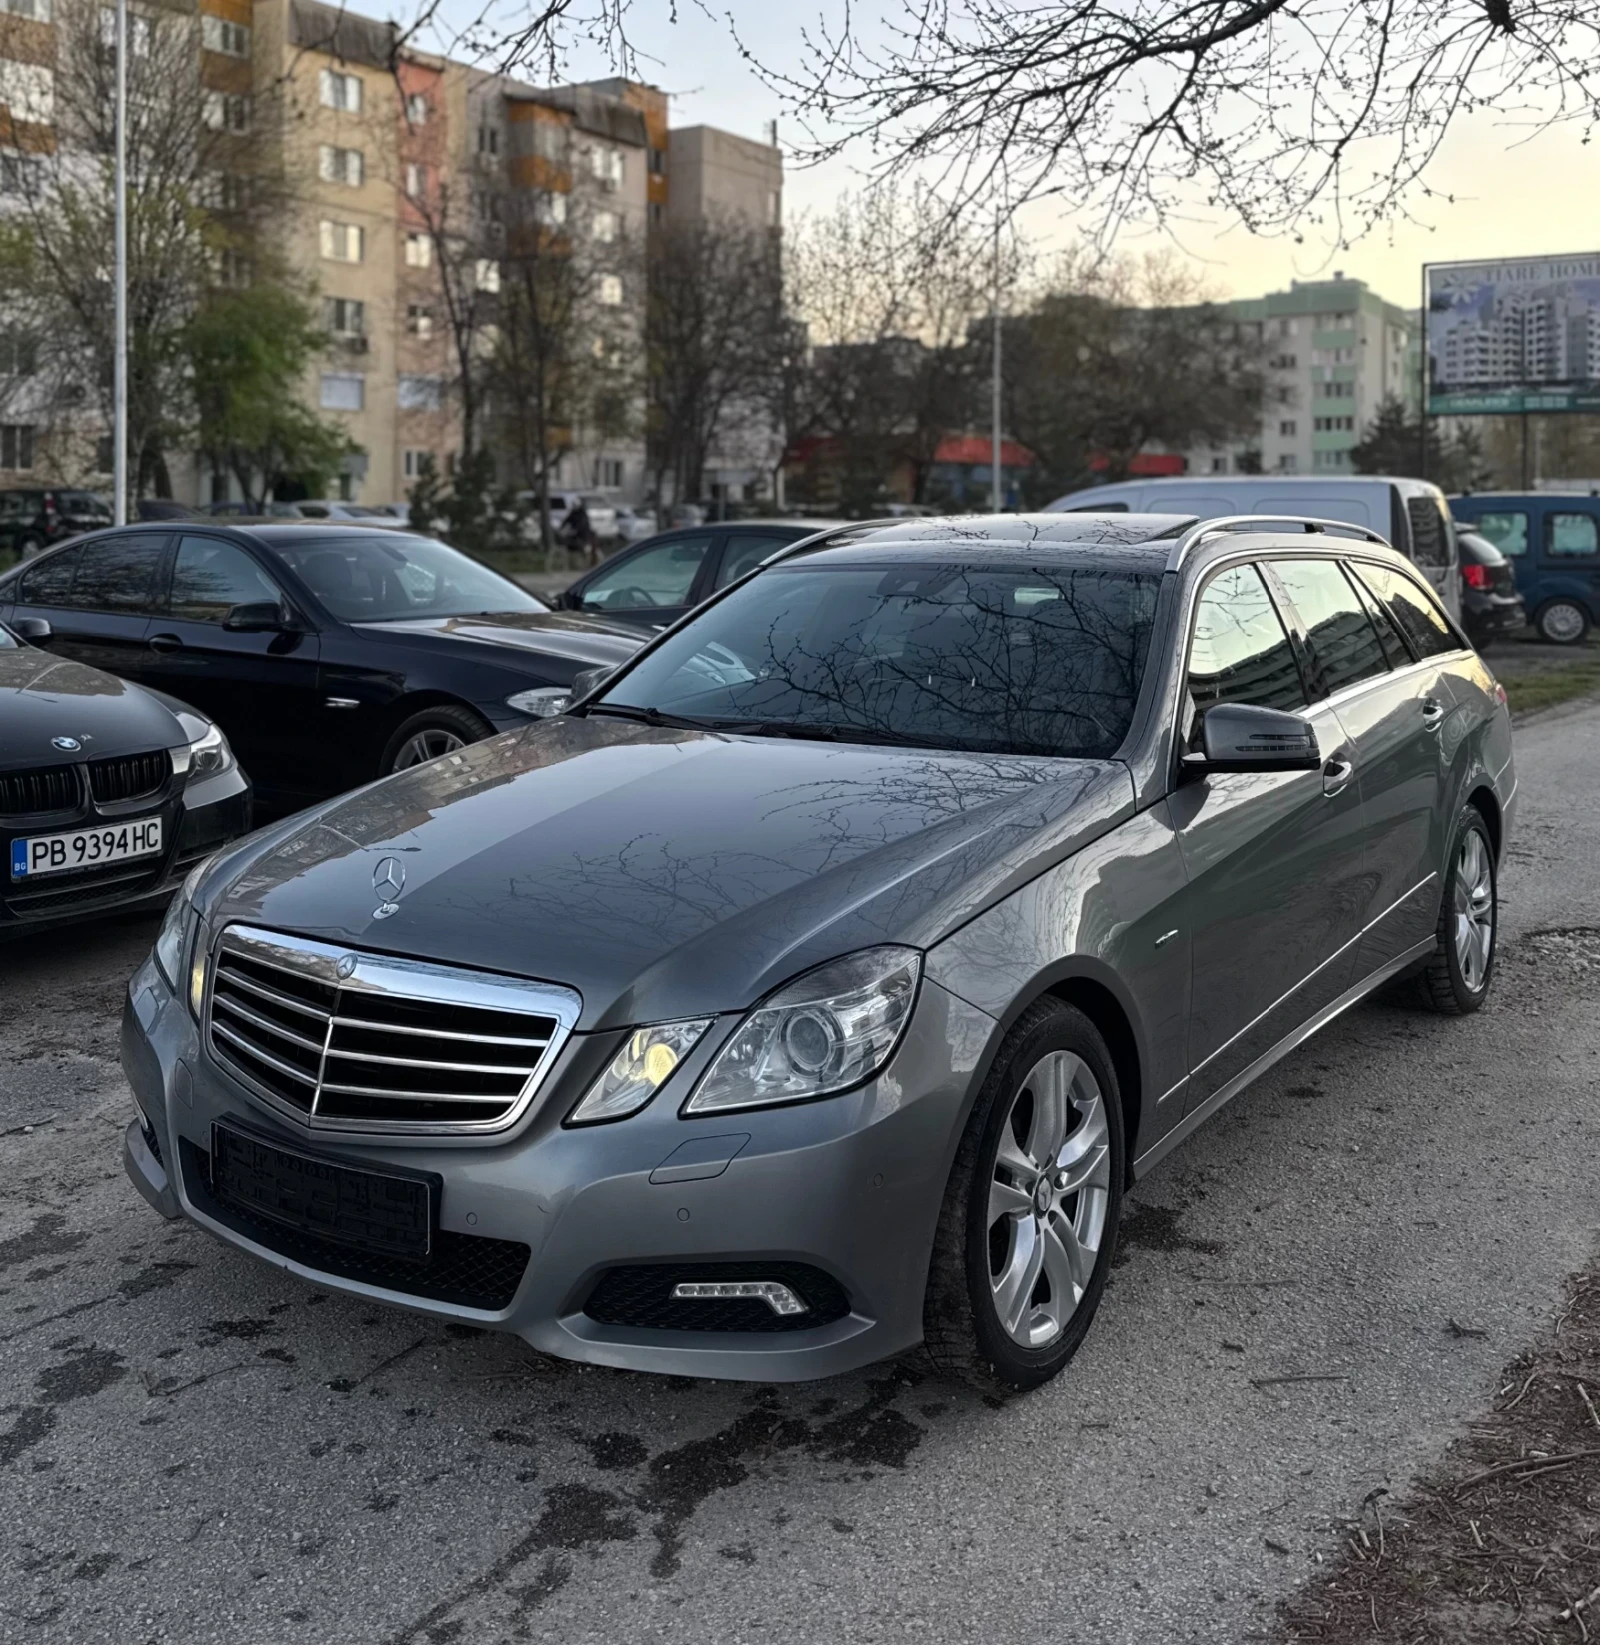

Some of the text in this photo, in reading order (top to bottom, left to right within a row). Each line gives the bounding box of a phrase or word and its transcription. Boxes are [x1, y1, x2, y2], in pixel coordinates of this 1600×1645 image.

[32, 839, 66, 869] PB
[72, 828, 128, 862] 9394
[133, 822, 158, 852] HC
[14, 862, 26, 872] BG
